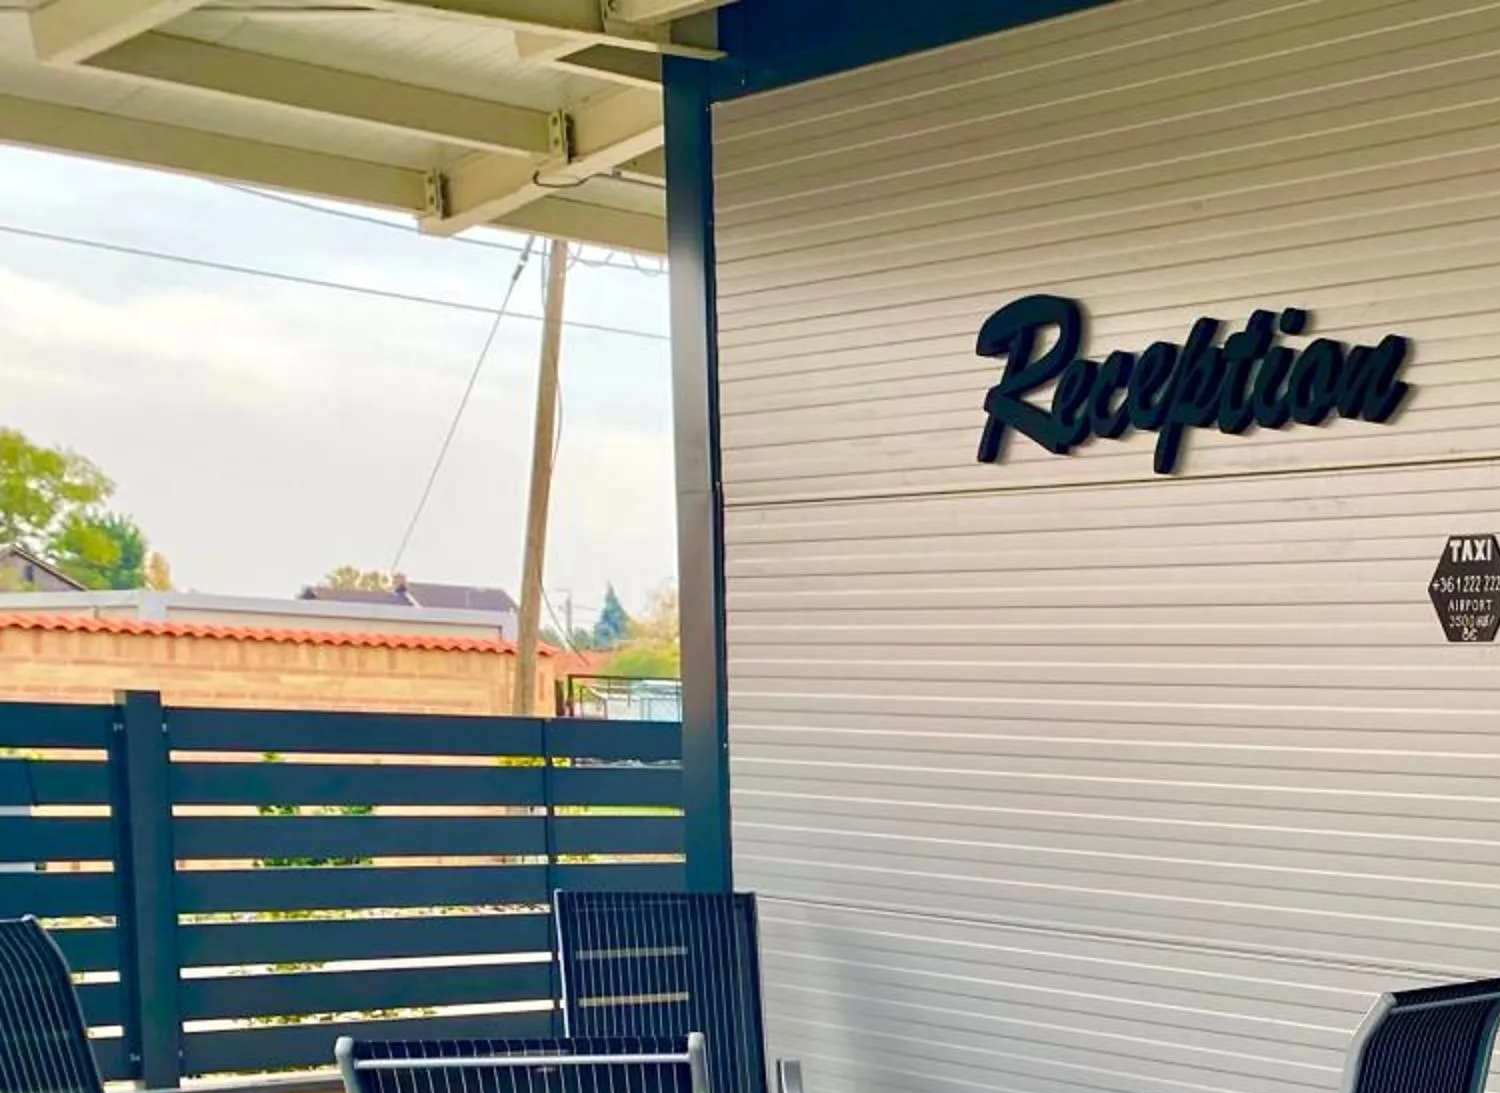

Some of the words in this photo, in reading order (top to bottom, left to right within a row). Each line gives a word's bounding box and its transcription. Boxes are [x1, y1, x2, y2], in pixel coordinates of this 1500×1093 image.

[975, 293, 1411, 474] Reception
[1449, 539, 1492, 562] TAXI
[1448, 599, 1492, 612] AIRPORT
